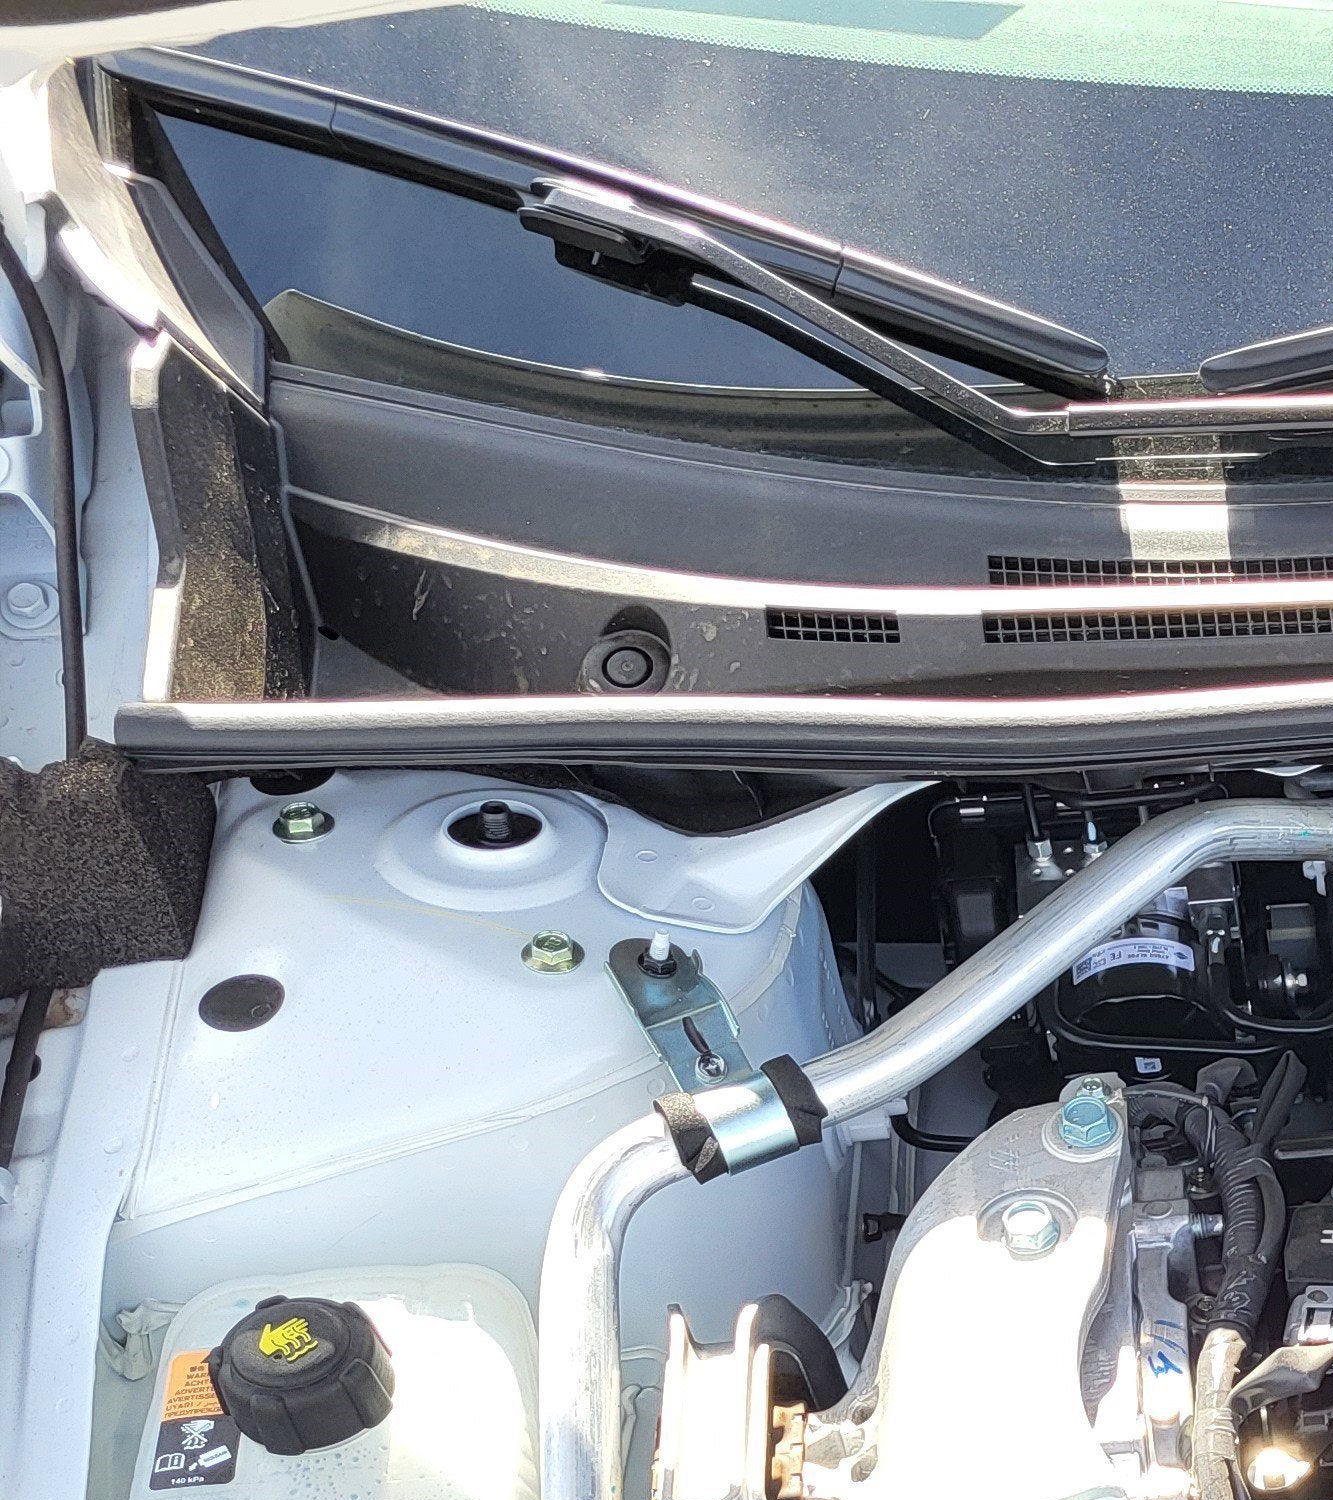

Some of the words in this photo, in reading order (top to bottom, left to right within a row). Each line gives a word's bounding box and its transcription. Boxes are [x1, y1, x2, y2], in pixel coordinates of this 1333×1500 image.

[186, 1371, 209, 1379] WAR
[183, 1378, 212, 1387] ACHT
[187, 1475, 204, 1483] kPa
